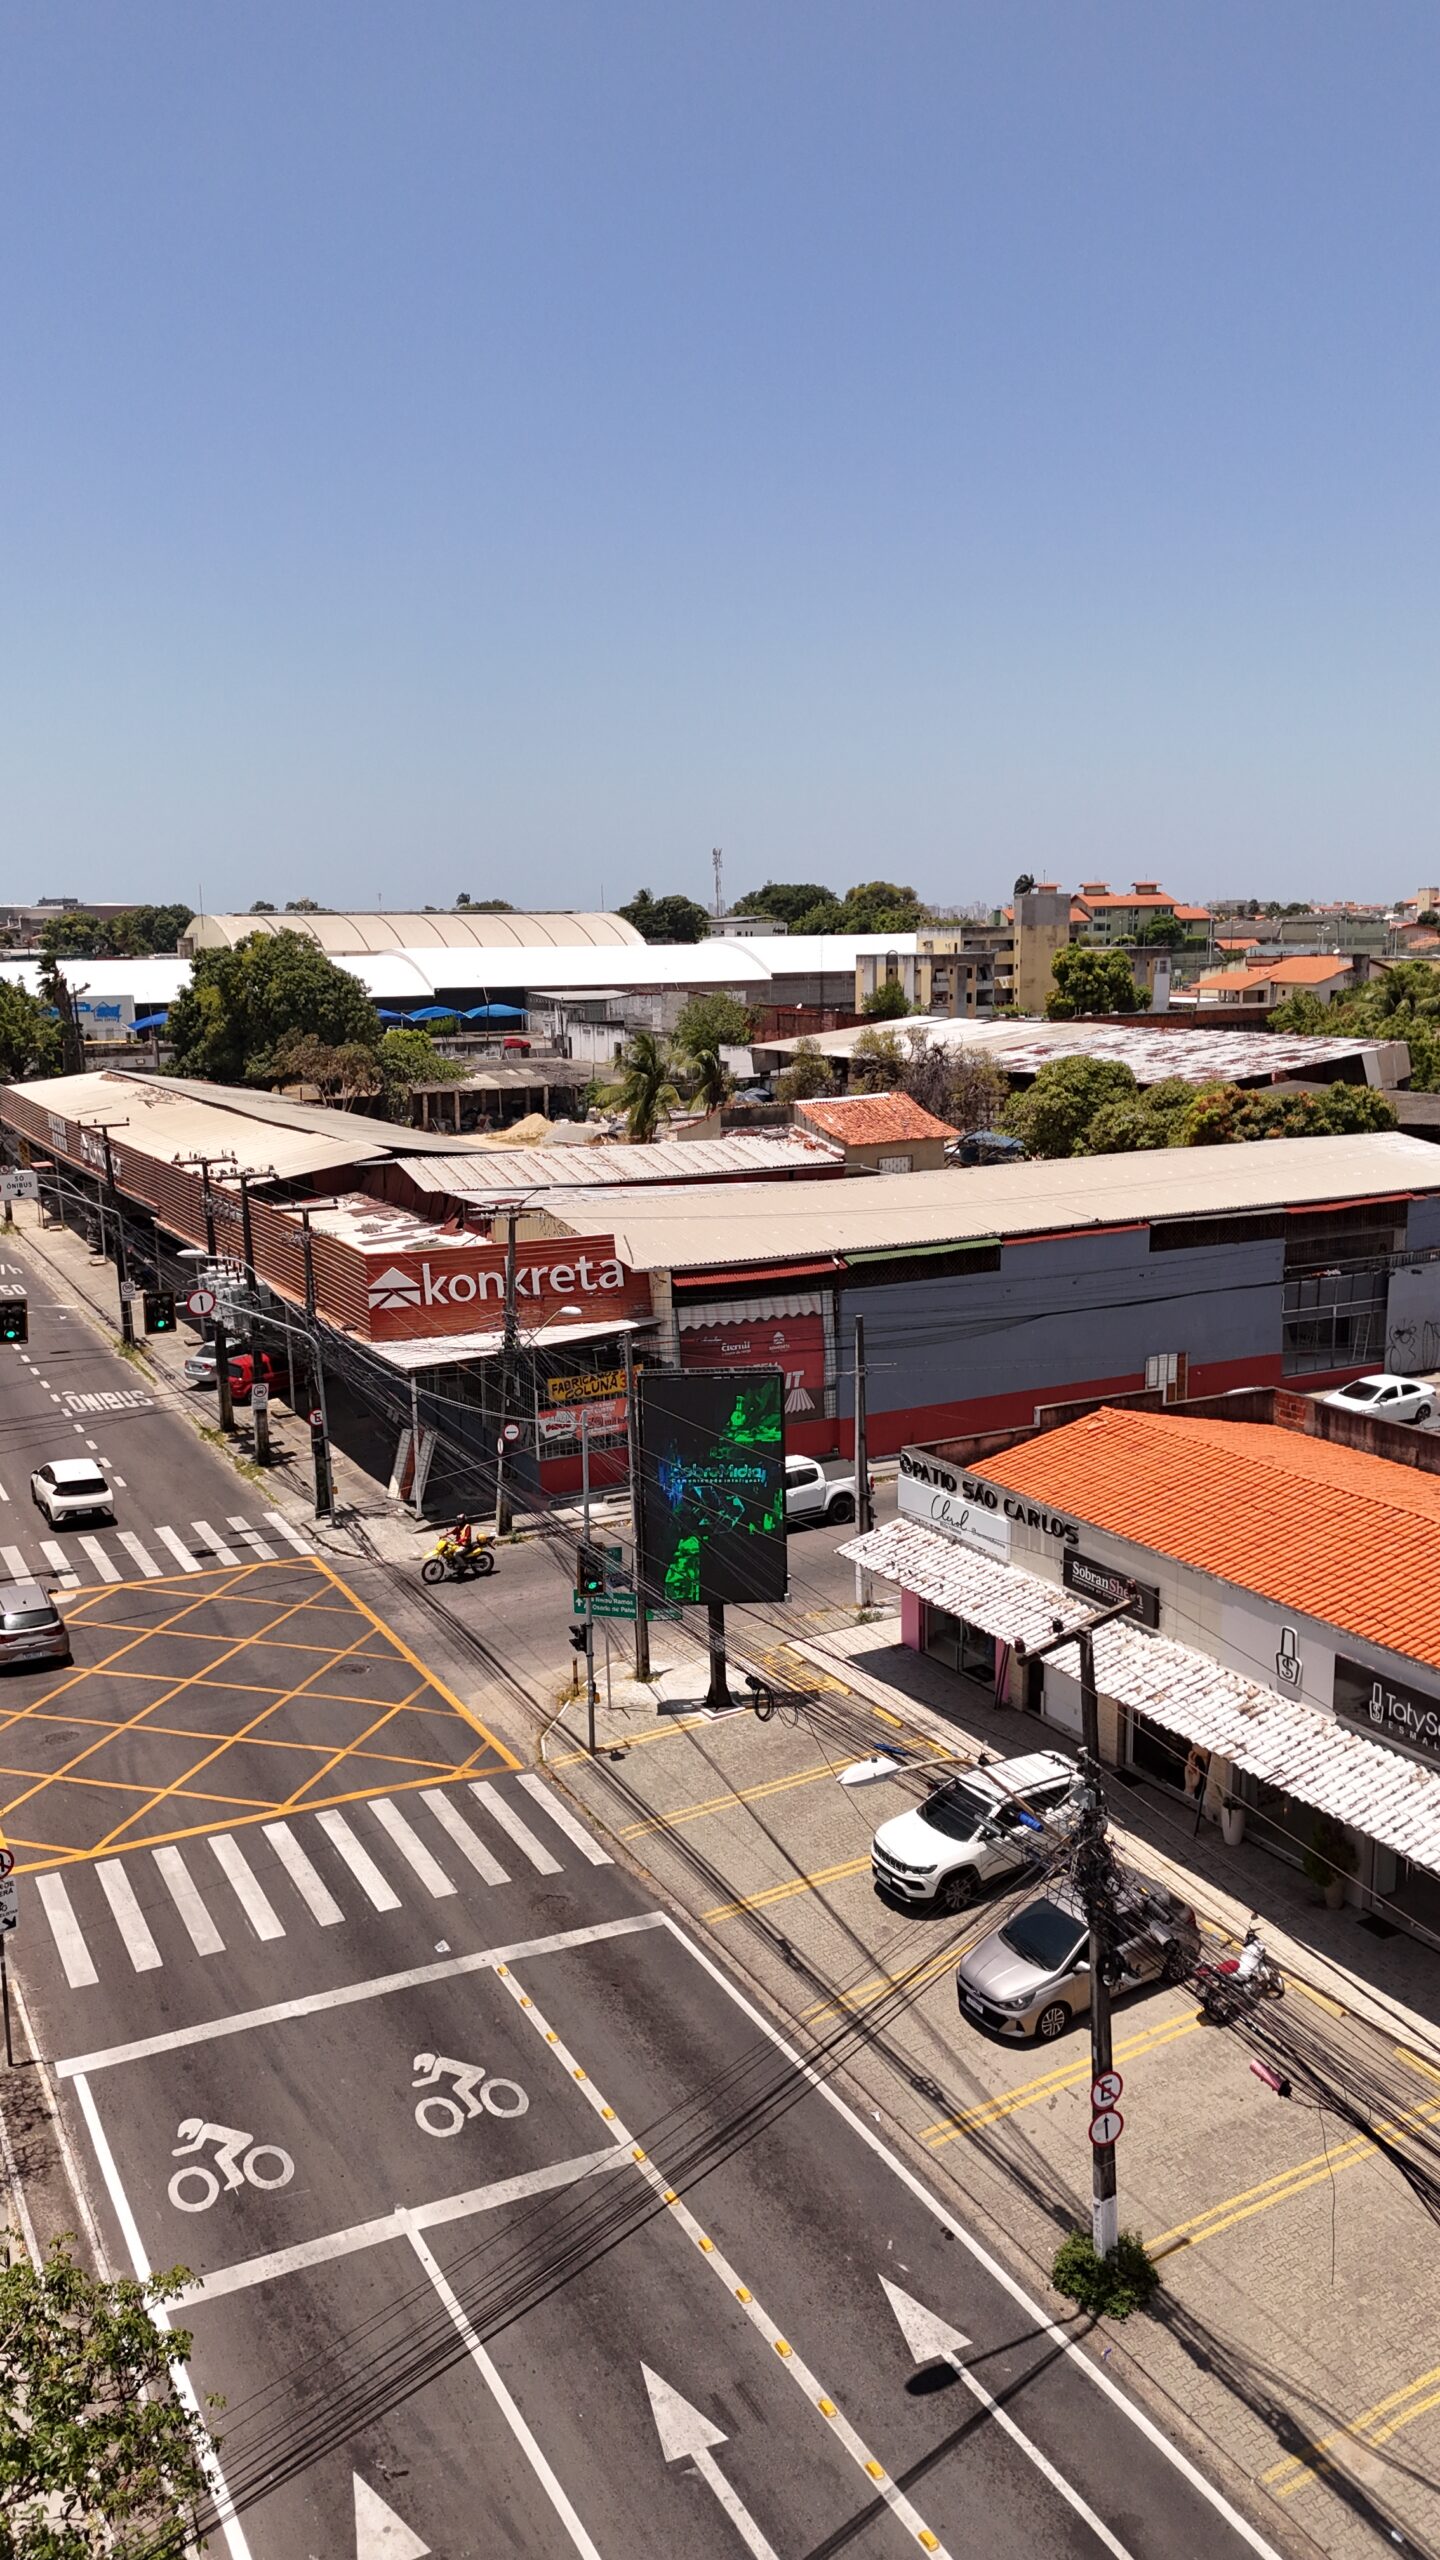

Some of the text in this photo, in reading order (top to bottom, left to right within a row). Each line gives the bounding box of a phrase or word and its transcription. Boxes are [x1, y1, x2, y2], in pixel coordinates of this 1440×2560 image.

[421, 1255, 625, 1306] konkreta
[565, 1376, 618, 1400] COLUNA
[61, 1390, 155, 1413] ÔNIBUS
[962, 1479, 998, 1510] SÃO
[1003, 1498, 1080, 1546] CARLOS
[1100, 2078, 1113, 2102] E
